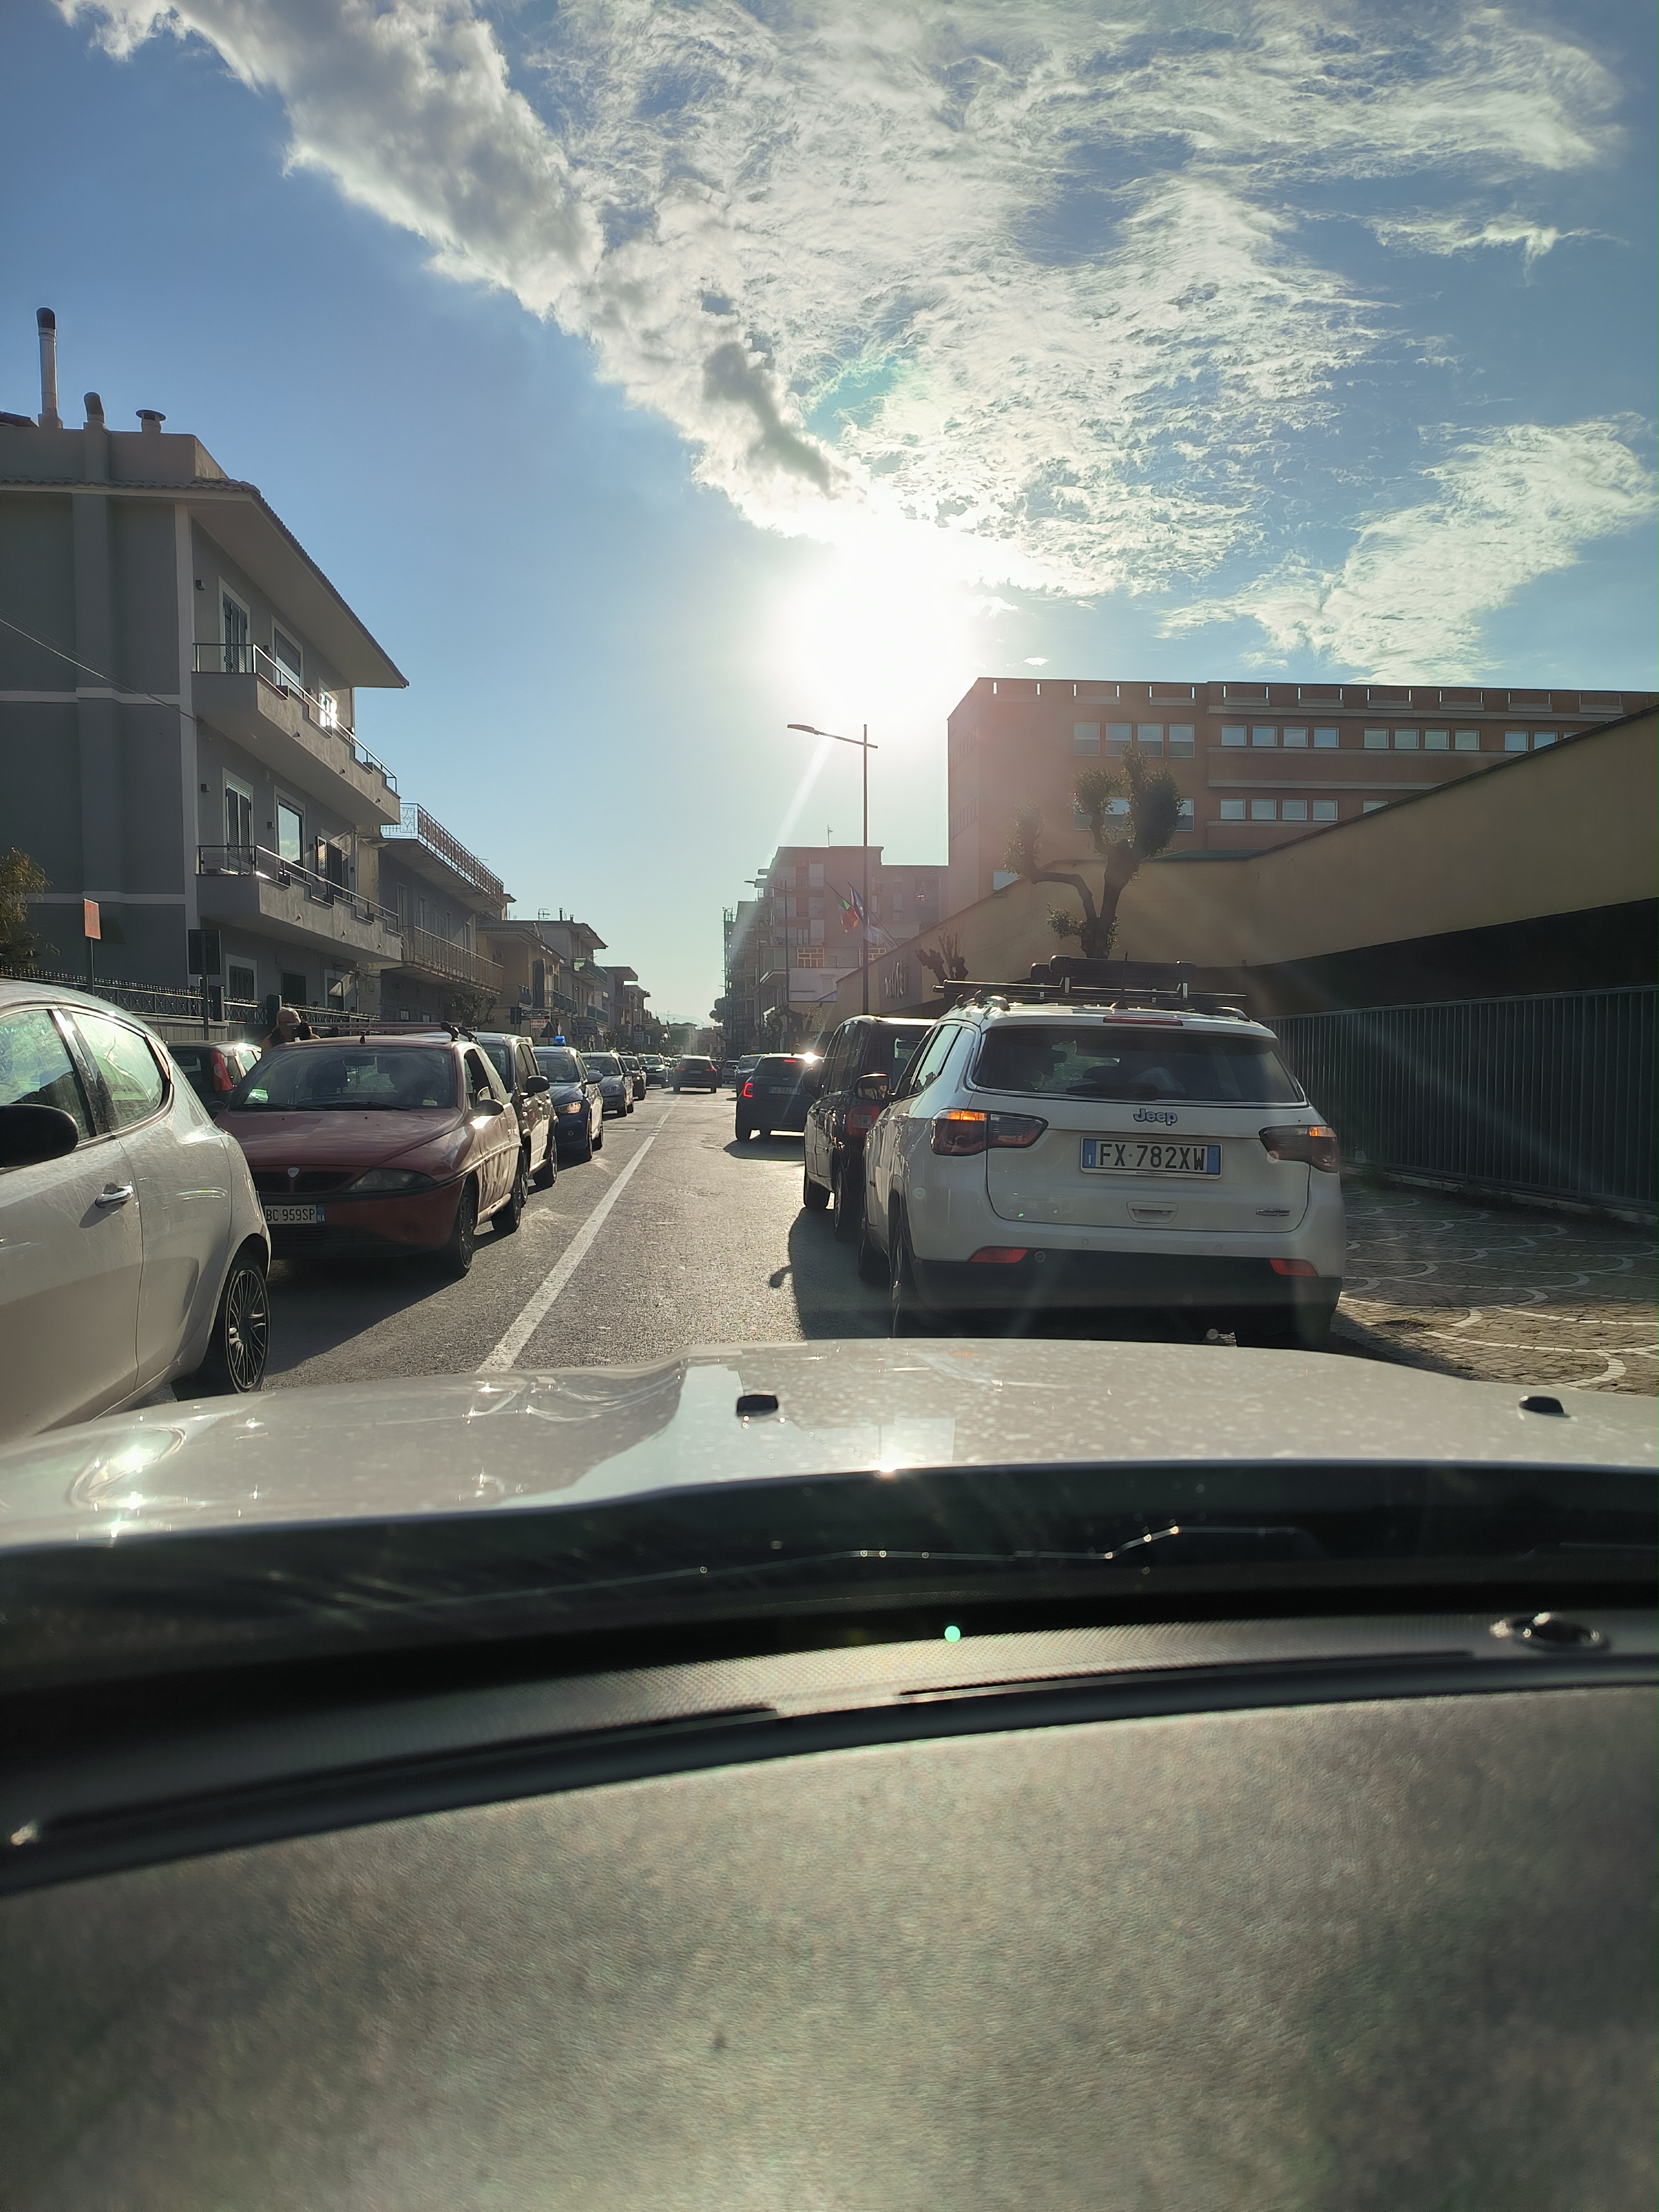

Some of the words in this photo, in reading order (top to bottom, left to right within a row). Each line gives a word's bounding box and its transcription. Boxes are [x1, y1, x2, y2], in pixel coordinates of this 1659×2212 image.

[1133, 1108, 1178, 1126] Jeep
[1100, 1143, 1126, 1166] FX
[1136, 1145, 1205, 1171] 782XW
[266, 1209, 279, 1221] BC
[282, 1208, 315, 1220] 959SP
